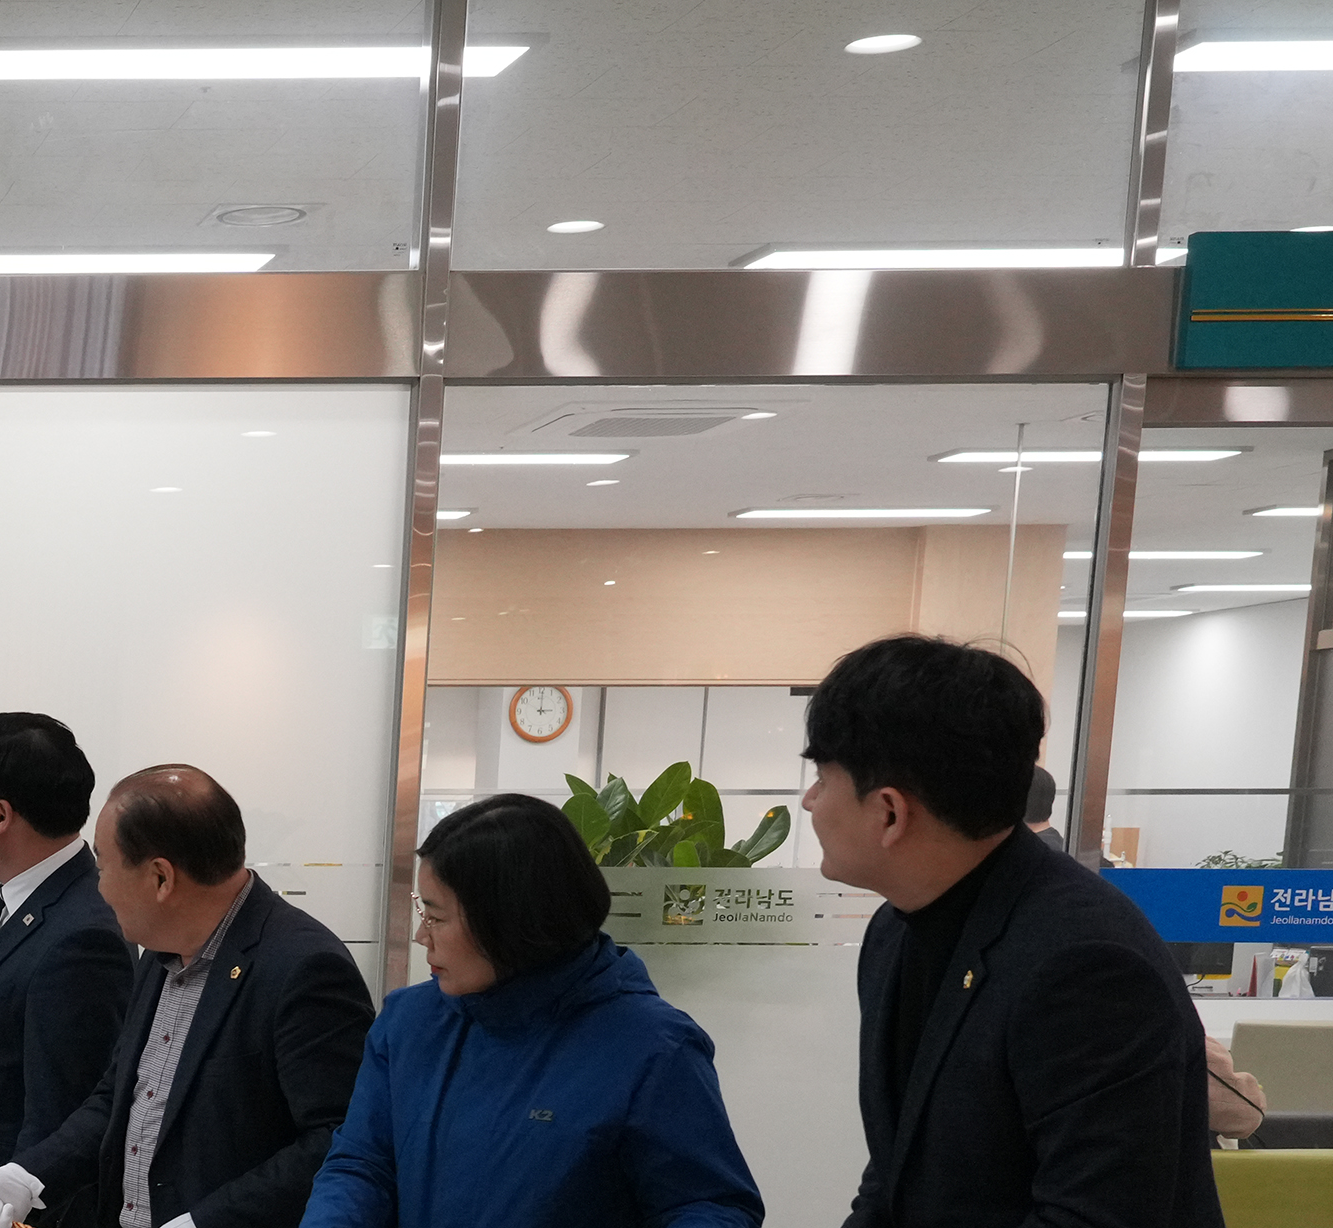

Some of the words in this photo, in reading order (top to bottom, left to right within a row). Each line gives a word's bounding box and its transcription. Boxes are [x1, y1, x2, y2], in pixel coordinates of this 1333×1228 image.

[712, 888, 795, 910] 전라남도
[712, 912, 793, 923] JeollaNamdo
[1269, 915, 1333, 925] Jeollanamdo
[528, 1109, 553, 1121] K2
